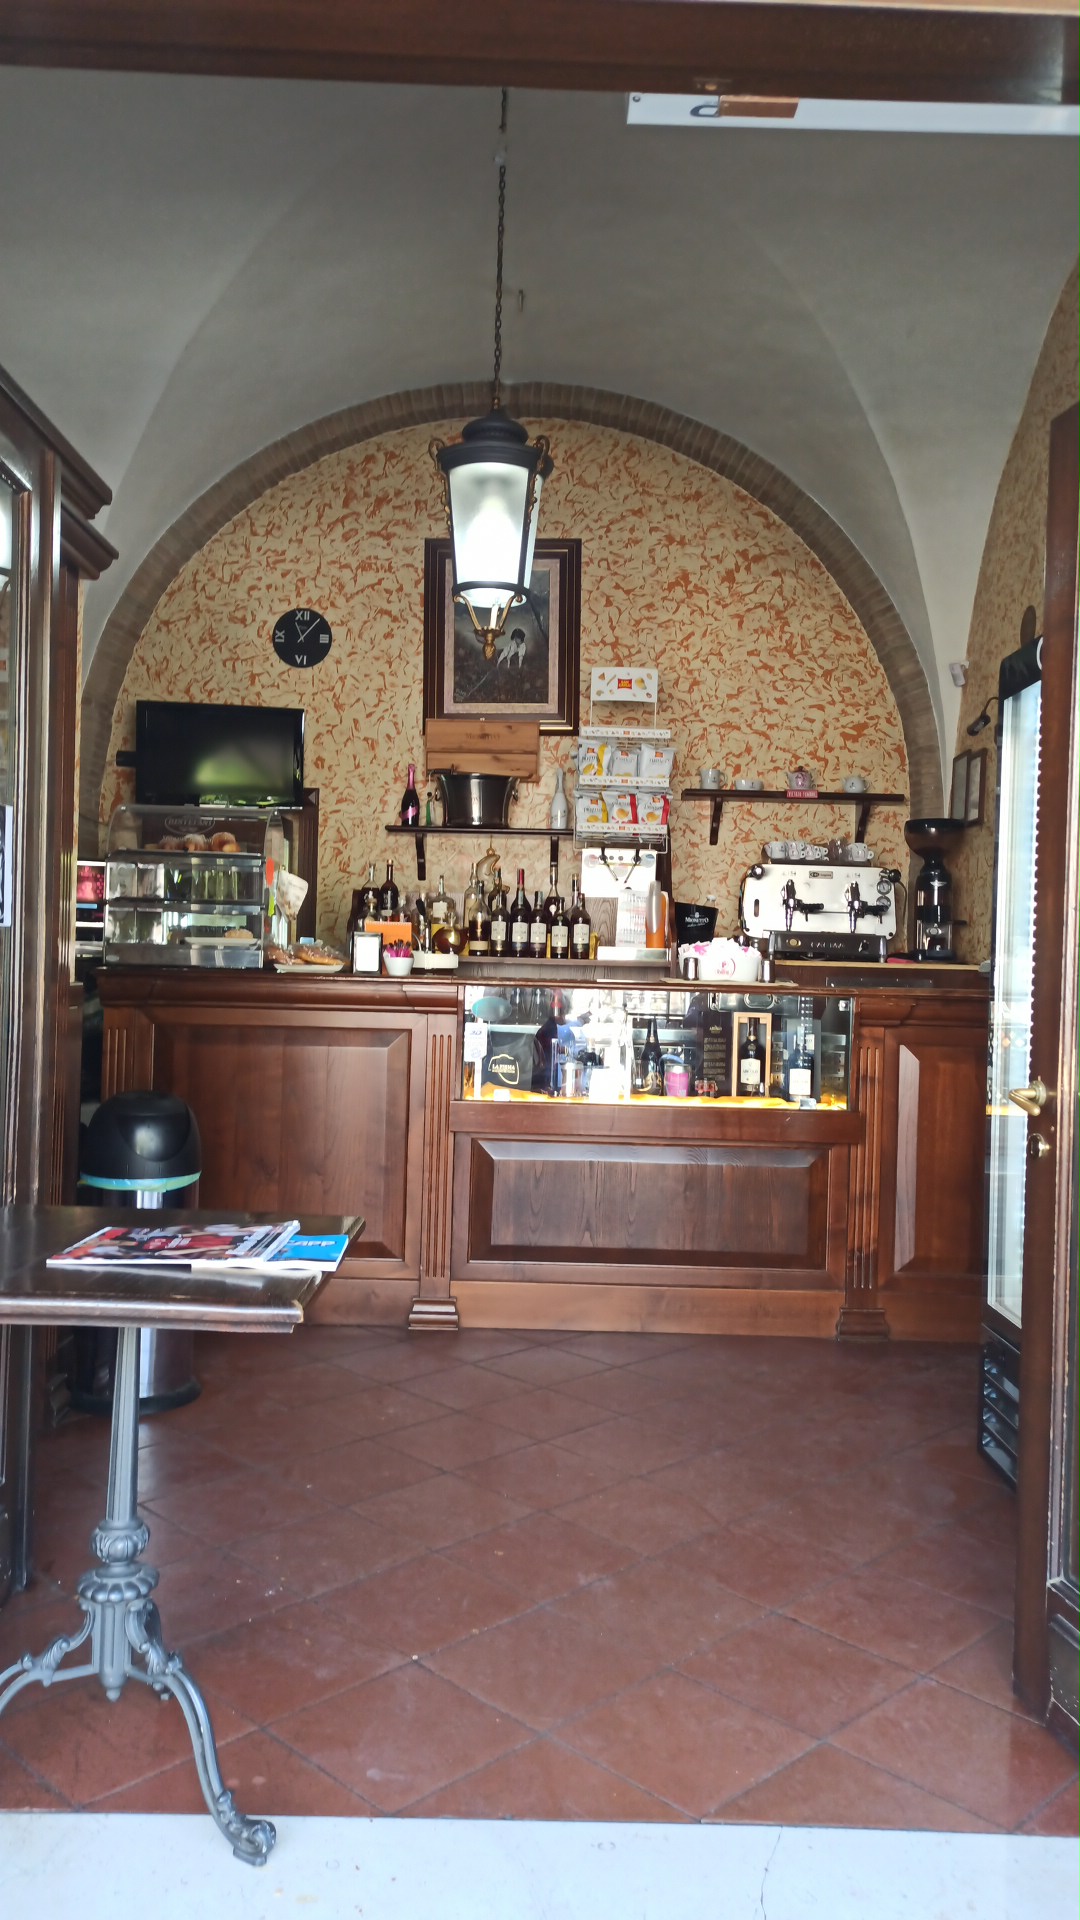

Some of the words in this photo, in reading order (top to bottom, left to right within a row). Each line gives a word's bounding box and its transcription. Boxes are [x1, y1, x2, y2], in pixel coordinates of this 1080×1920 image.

[295, 611, 310, 621] XII
[275, 630, 285, 643] IX
[319, 634, 330, 643] III
[294, 655, 307, 665] VI
